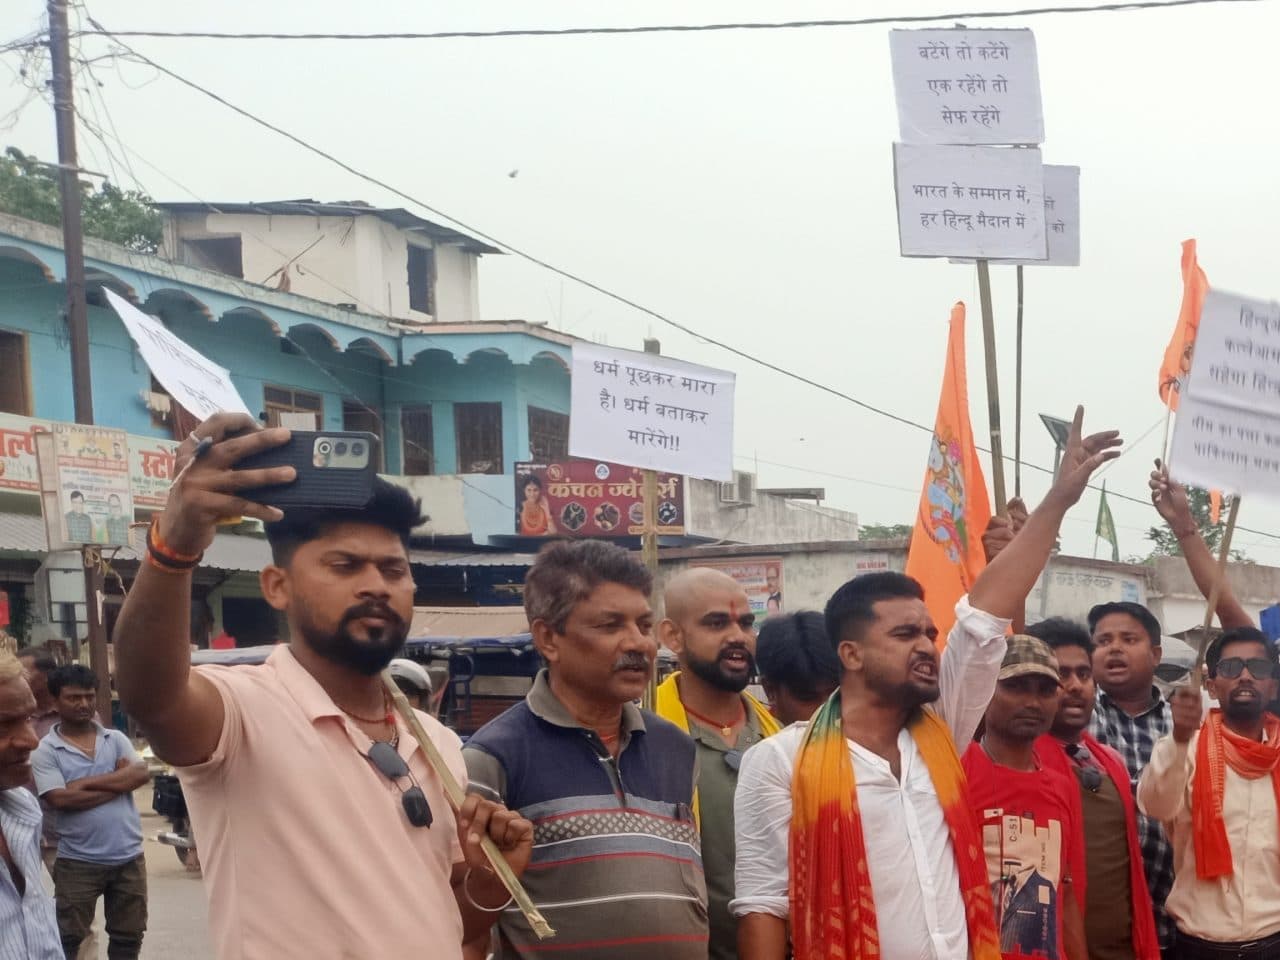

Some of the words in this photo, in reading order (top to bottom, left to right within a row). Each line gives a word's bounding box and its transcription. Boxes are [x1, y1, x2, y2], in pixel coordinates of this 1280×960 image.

[918, 40, 950, 60] बटेंगे
[956, 42, 971, 60] तो
[979, 40, 1009, 60] कटेंगे
[927, 79, 952, 96] एक
[957, 74, 987, 97] रहेंगे
[992, 74, 1008, 94] तो
[942, 106, 967, 125] सेफ
[973, 104, 1001, 128] रहेंगे
[913, 184, 947, 198] भारत
[953, 182, 964, 198] के
[969, 186, 1011, 201] सम्मान
[920, 212, 937, 229] हर
[943, 209, 974, 231] हिन्दू
[978, 211, 1009, 228] मैदान
[1015, 212, 1027, 229] में
[593, 360, 620, 377] धर्म
[626, 367, 676, 388] पूछकर
[681, 377, 717, 396] मारा
[624, 396, 650, 415] धर्म
[655, 403, 709, 425] बताकर
[547, 478, 604, 499] कंचन
[607, 478, 678, 499] ज्वेर्स
